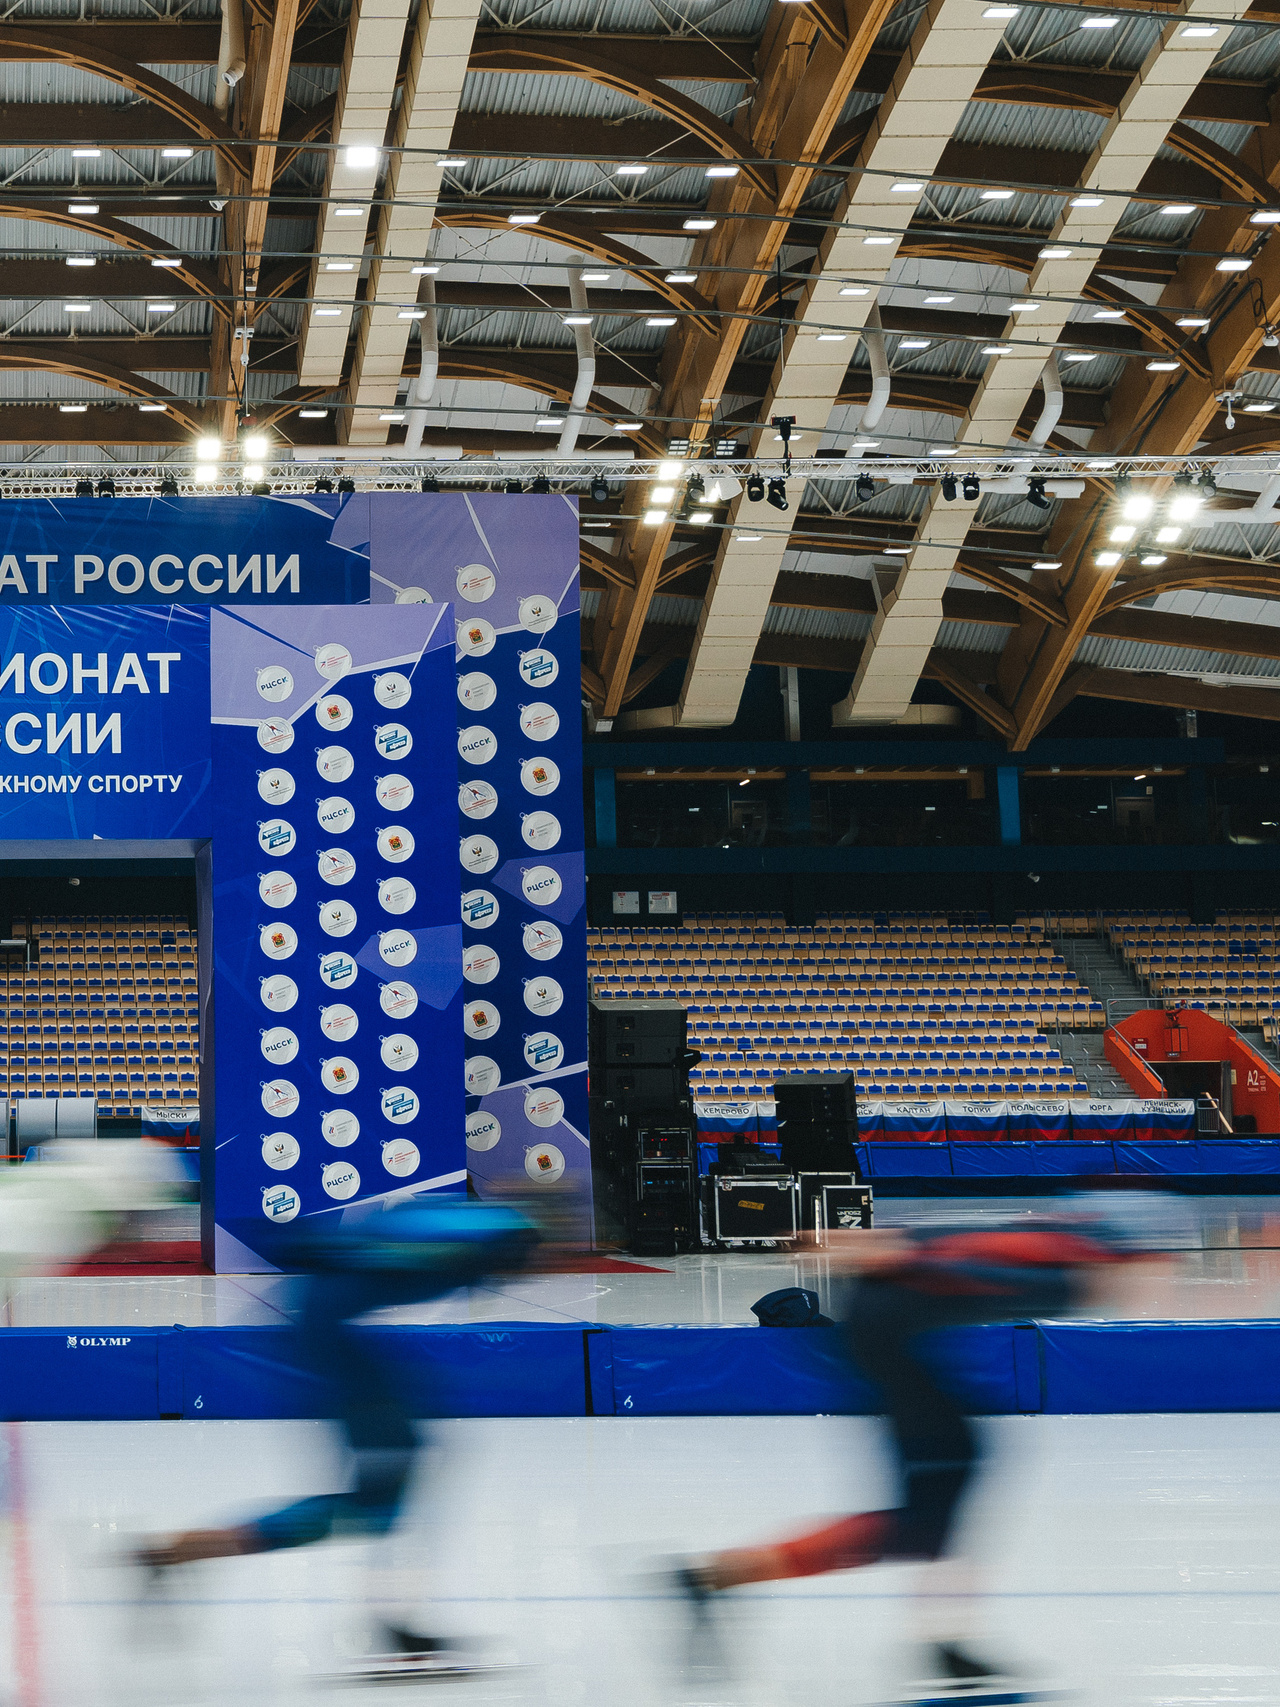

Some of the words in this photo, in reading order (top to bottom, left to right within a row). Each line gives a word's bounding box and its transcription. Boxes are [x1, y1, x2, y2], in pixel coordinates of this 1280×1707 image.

[74, 553, 300, 595] РОССИИ
[260, 676, 289, 691] РЦССК
[462, 737, 491, 752] РЦССК
[88, 774, 183, 793] СПОРТУ
[321, 808, 350, 822] РЦССК
[527, 878, 556, 893] РЦССК
[383, 940, 412, 954] РЦССК
[265, 1038, 294, 1053] РЦССК
[704, 1107, 750, 1115] КЕМЕРОВО
[896, 1106, 931, 1114] КАЛТАН
[962, 1105, 991, 1113] ТОПКИ
[1011, 1104, 1064, 1112] ПОЛЫСАЕВО
[1089, 1104, 1113, 1112] ЮРГА
[466, 1123, 495, 1138] РЦССК
[326, 1172, 355, 1187] РЦССК
[80, 1337, 131, 1346] OLYMP
[194, 1395, 203, 1409] 6
[624, 1395, 633, 1409] 6
